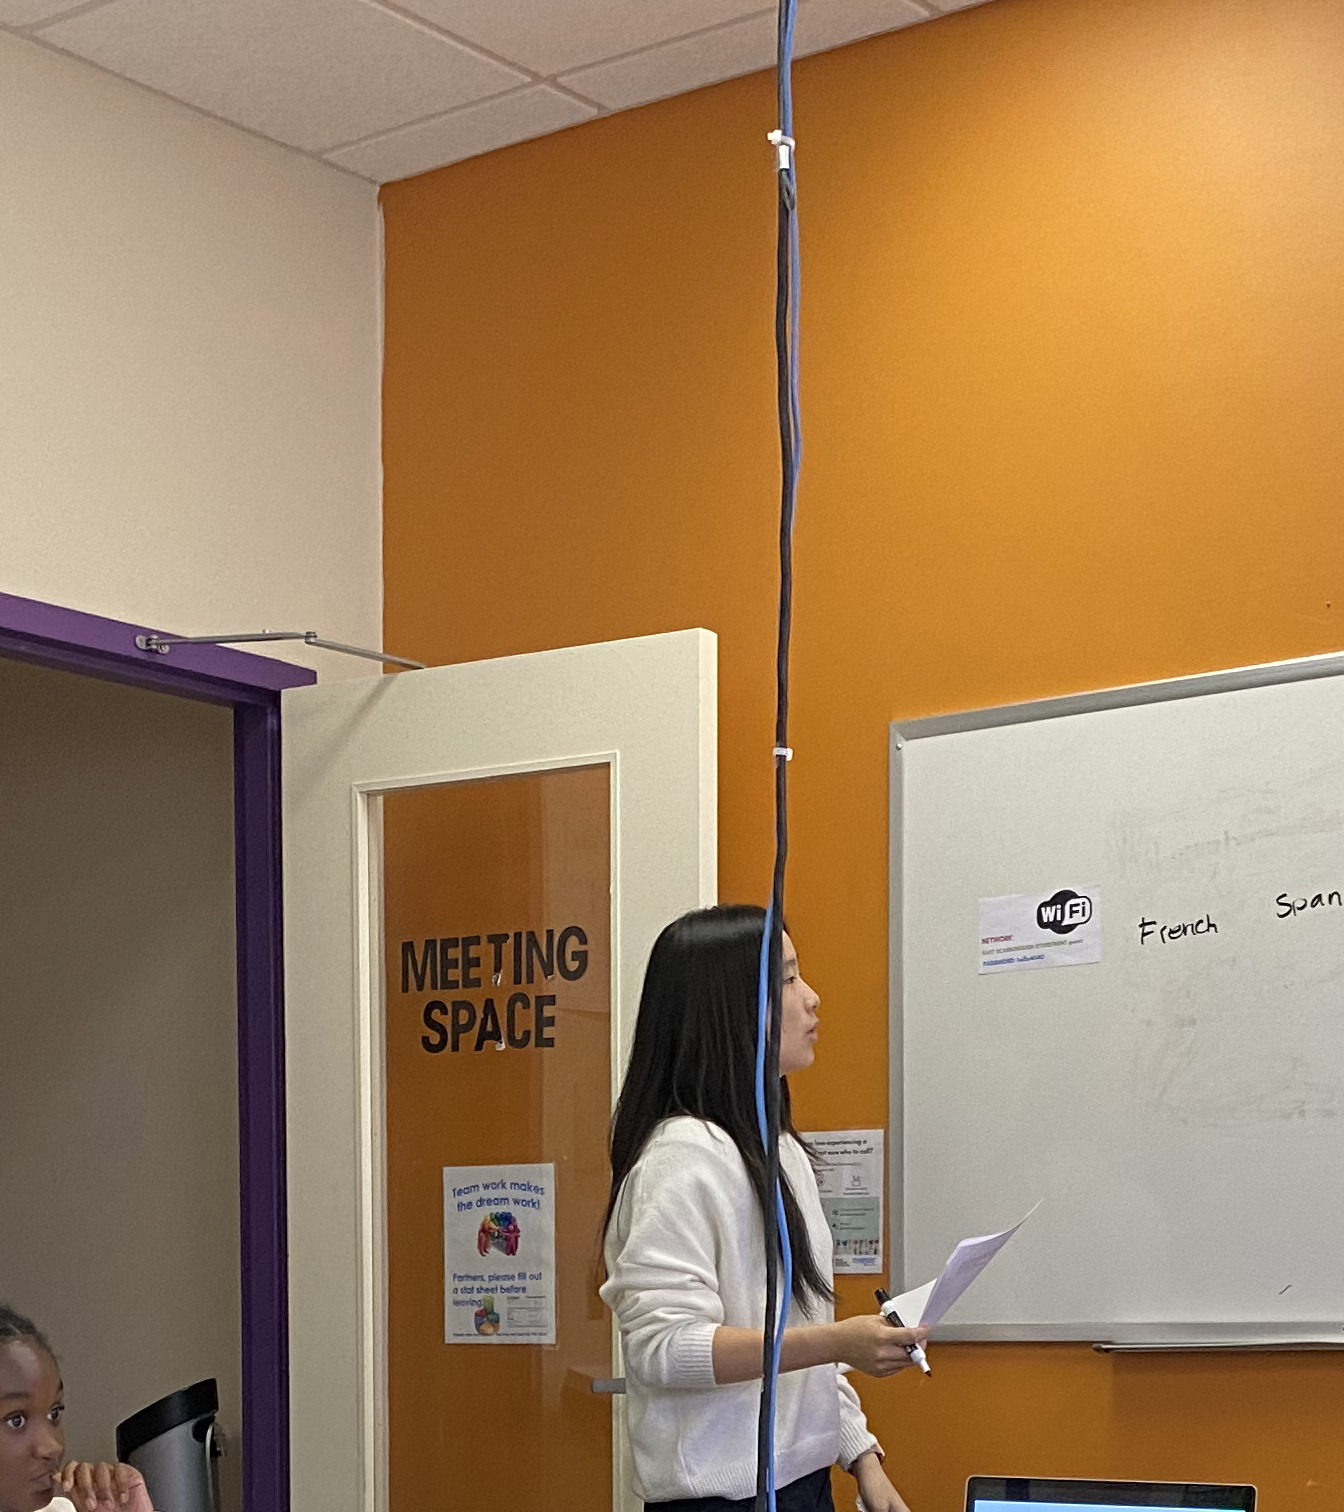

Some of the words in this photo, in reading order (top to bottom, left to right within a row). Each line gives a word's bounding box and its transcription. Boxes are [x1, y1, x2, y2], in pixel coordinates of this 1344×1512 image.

[1139, 914, 1218, 945] French
[401, 925, 588, 993] MEETING
[421, 992, 556, 1053] SPACE
[452, 1184, 480, 1198] Team
[482, 1179, 507, 1191] work
[510, 1180, 545, 1196] makes
[457, 1200, 473, 1212] the
[476, 1196, 509, 1208] dream
[488, 1272, 516, 1284] please
[517, 1271, 527, 1281] fill
[528, 1271, 542, 1281] out
[476, 1284, 499, 1294] sheet
[499, 1284, 527, 1294] before
